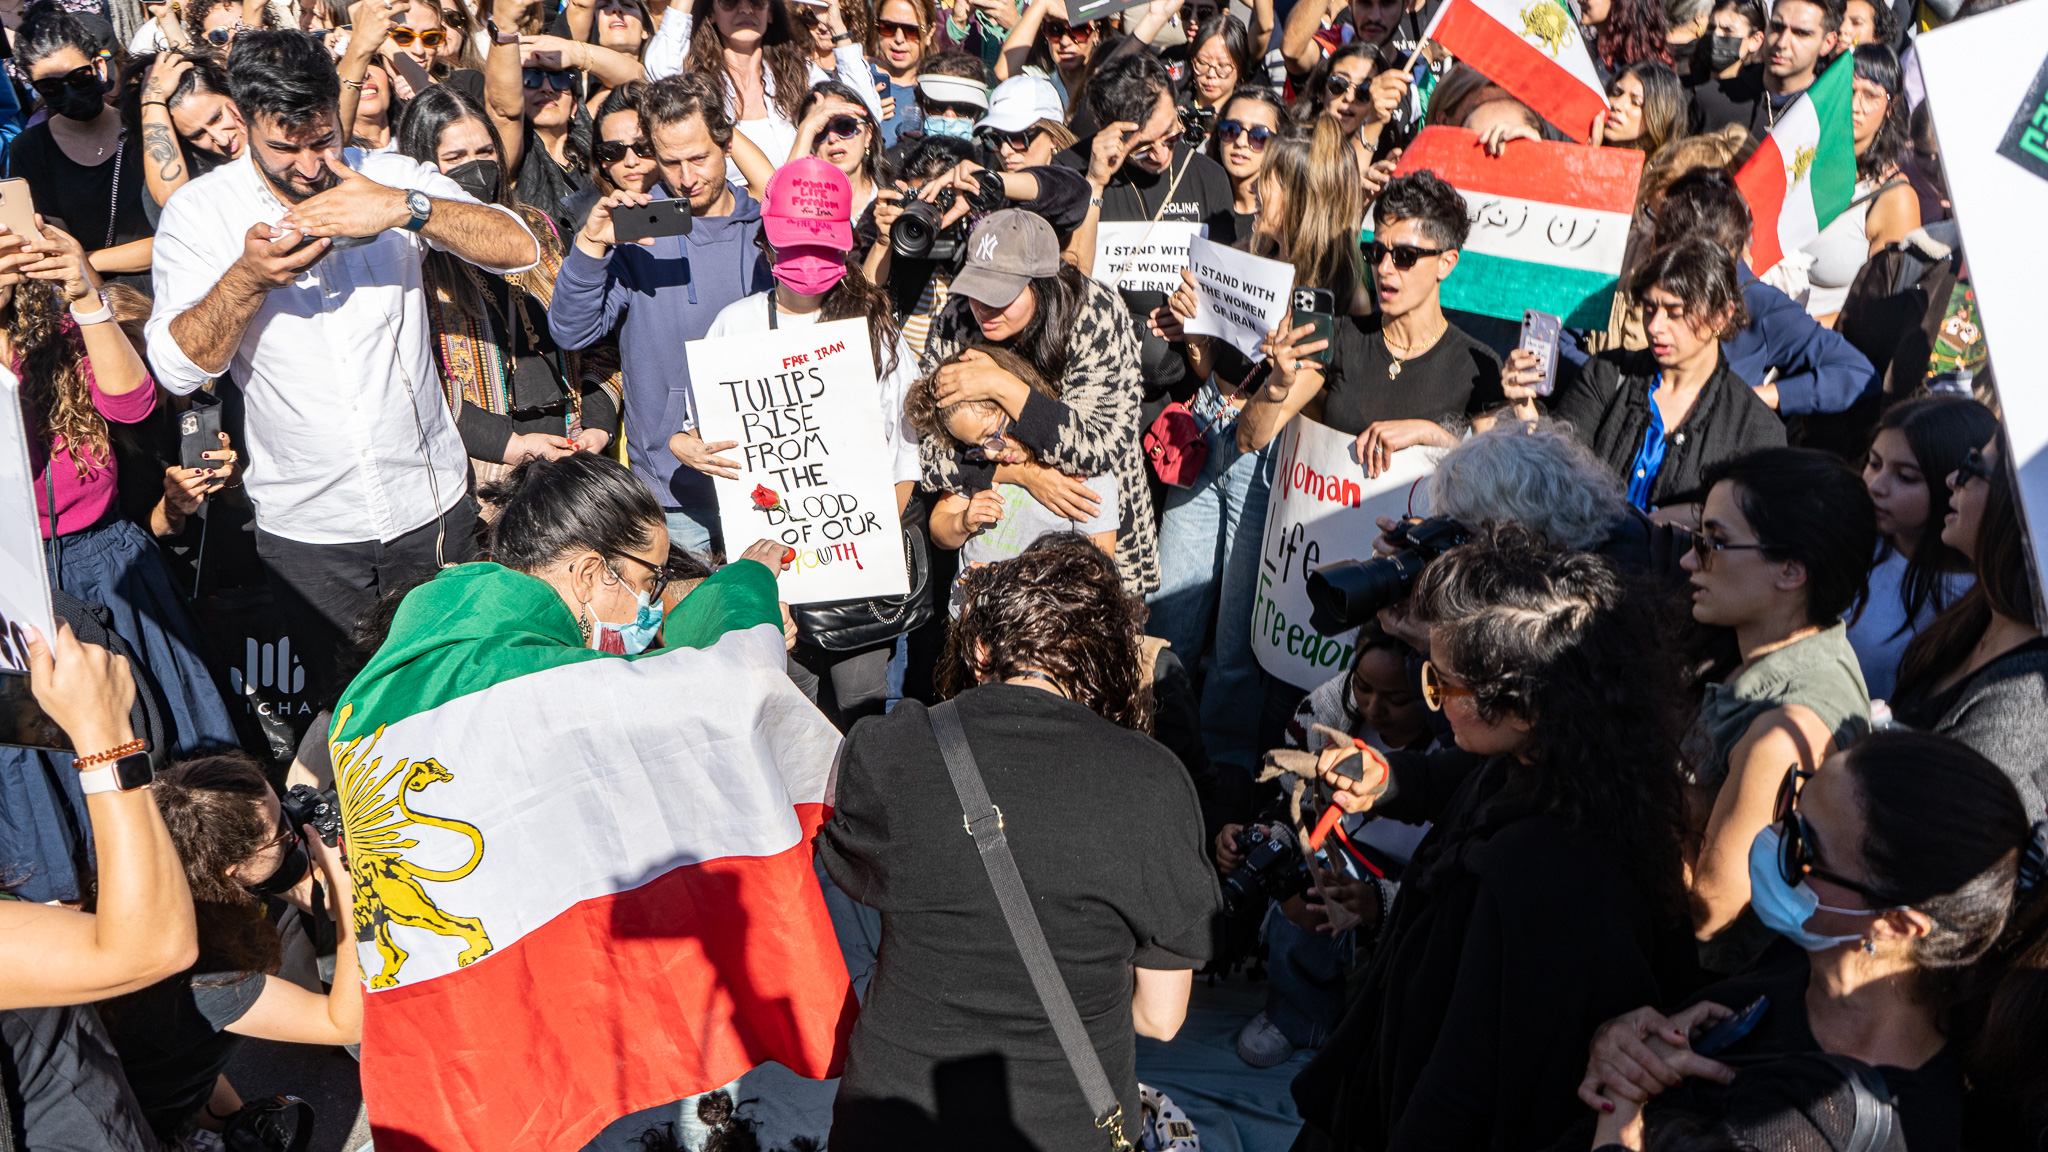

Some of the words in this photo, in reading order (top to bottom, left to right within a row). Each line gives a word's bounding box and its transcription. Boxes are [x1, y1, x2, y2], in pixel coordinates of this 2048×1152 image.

[1470, 200, 1528, 238] زندگ
[1547, 215, 1600, 251] زن
[975, 232, 999, 261] NY
[1105, 245, 1109, 255] I
[1114, 244, 1156, 256] STAND
[1108, 262, 1134, 273] THE
[1118, 279, 1137, 291] OF
[1141, 280, 1174, 291] IRAN
[1195, 261, 1199, 273] I
[1201, 264, 1239, 289] STAND
[1241, 281, 1276, 302] WITH
[1199, 281, 1221, 300] THE
[1222, 291, 1267, 320] WOMEN
[1212, 303, 1227, 317] OF
[1229, 311, 1257, 331] IRAN
[782, 353, 810, 369] FREE
[814, 340, 846, 361] IRAN
[719, 367, 826, 412] TULIPS
[741, 403, 821, 443] RISE
[743, 432, 829, 473] FROM
[1278, 423, 1361, 508] Woman
[768, 462, 828, 493] THE
[781, 524, 812, 545] OF
[821, 511, 882, 541] OUR
[1264, 501, 1320, 583] Life
